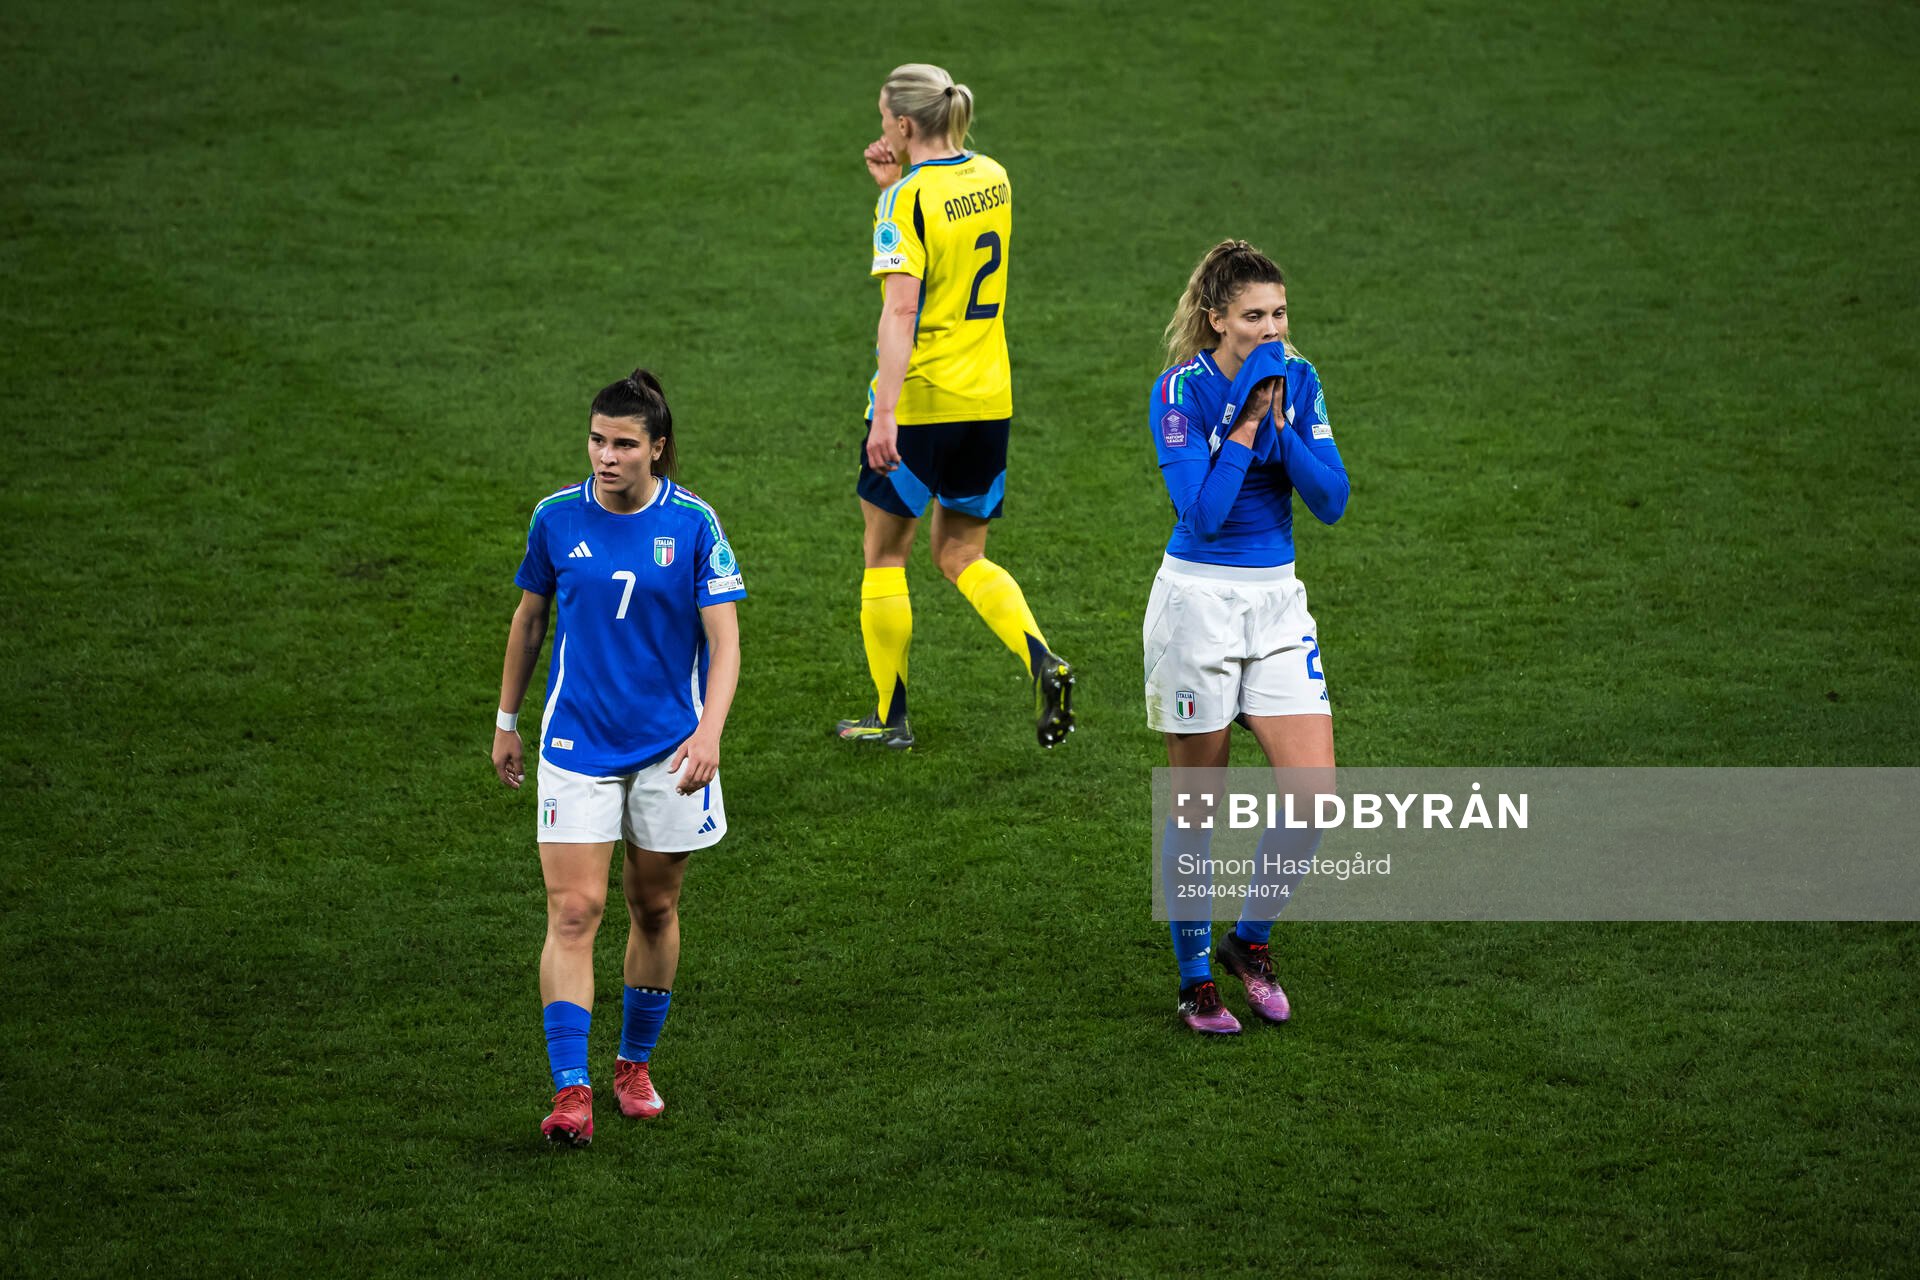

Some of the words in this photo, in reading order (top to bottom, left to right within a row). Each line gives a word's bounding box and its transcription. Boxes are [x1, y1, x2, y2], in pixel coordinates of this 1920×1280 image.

[944, 182, 1009, 222] ANDERSSON
[965, 231, 1002, 320] 2
[611, 571, 637, 620] 7
